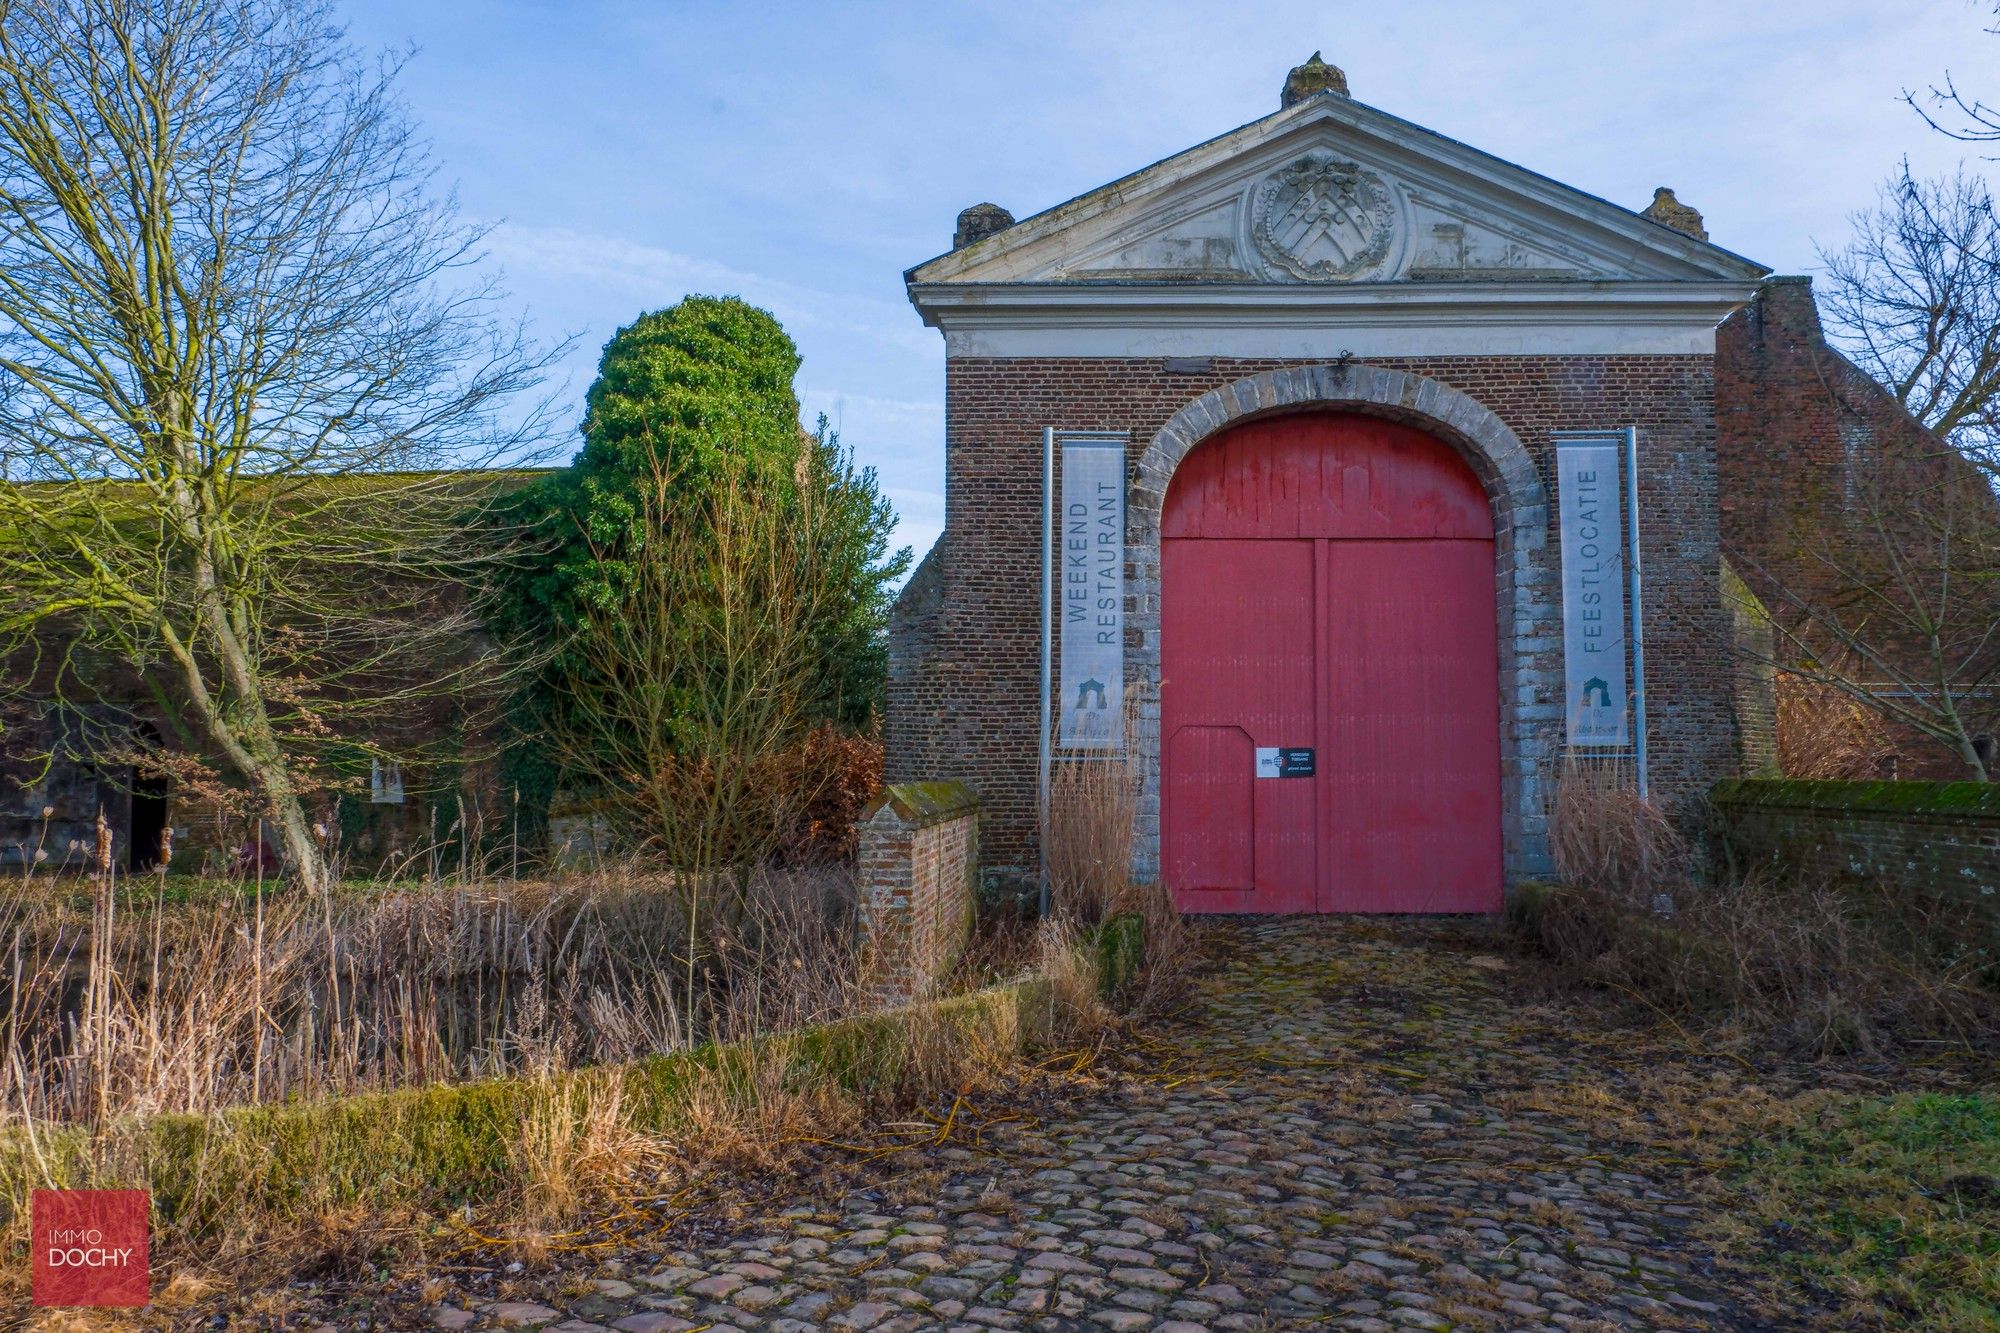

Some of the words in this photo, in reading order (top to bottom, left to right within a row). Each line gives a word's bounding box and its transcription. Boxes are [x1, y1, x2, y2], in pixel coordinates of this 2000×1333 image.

[1068, 503, 1088, 624] WEEKEND
[1097, 482, 1117, 645] RESTAURANT
[1577, 471, 1601, 653] FEESTLOCATIE
